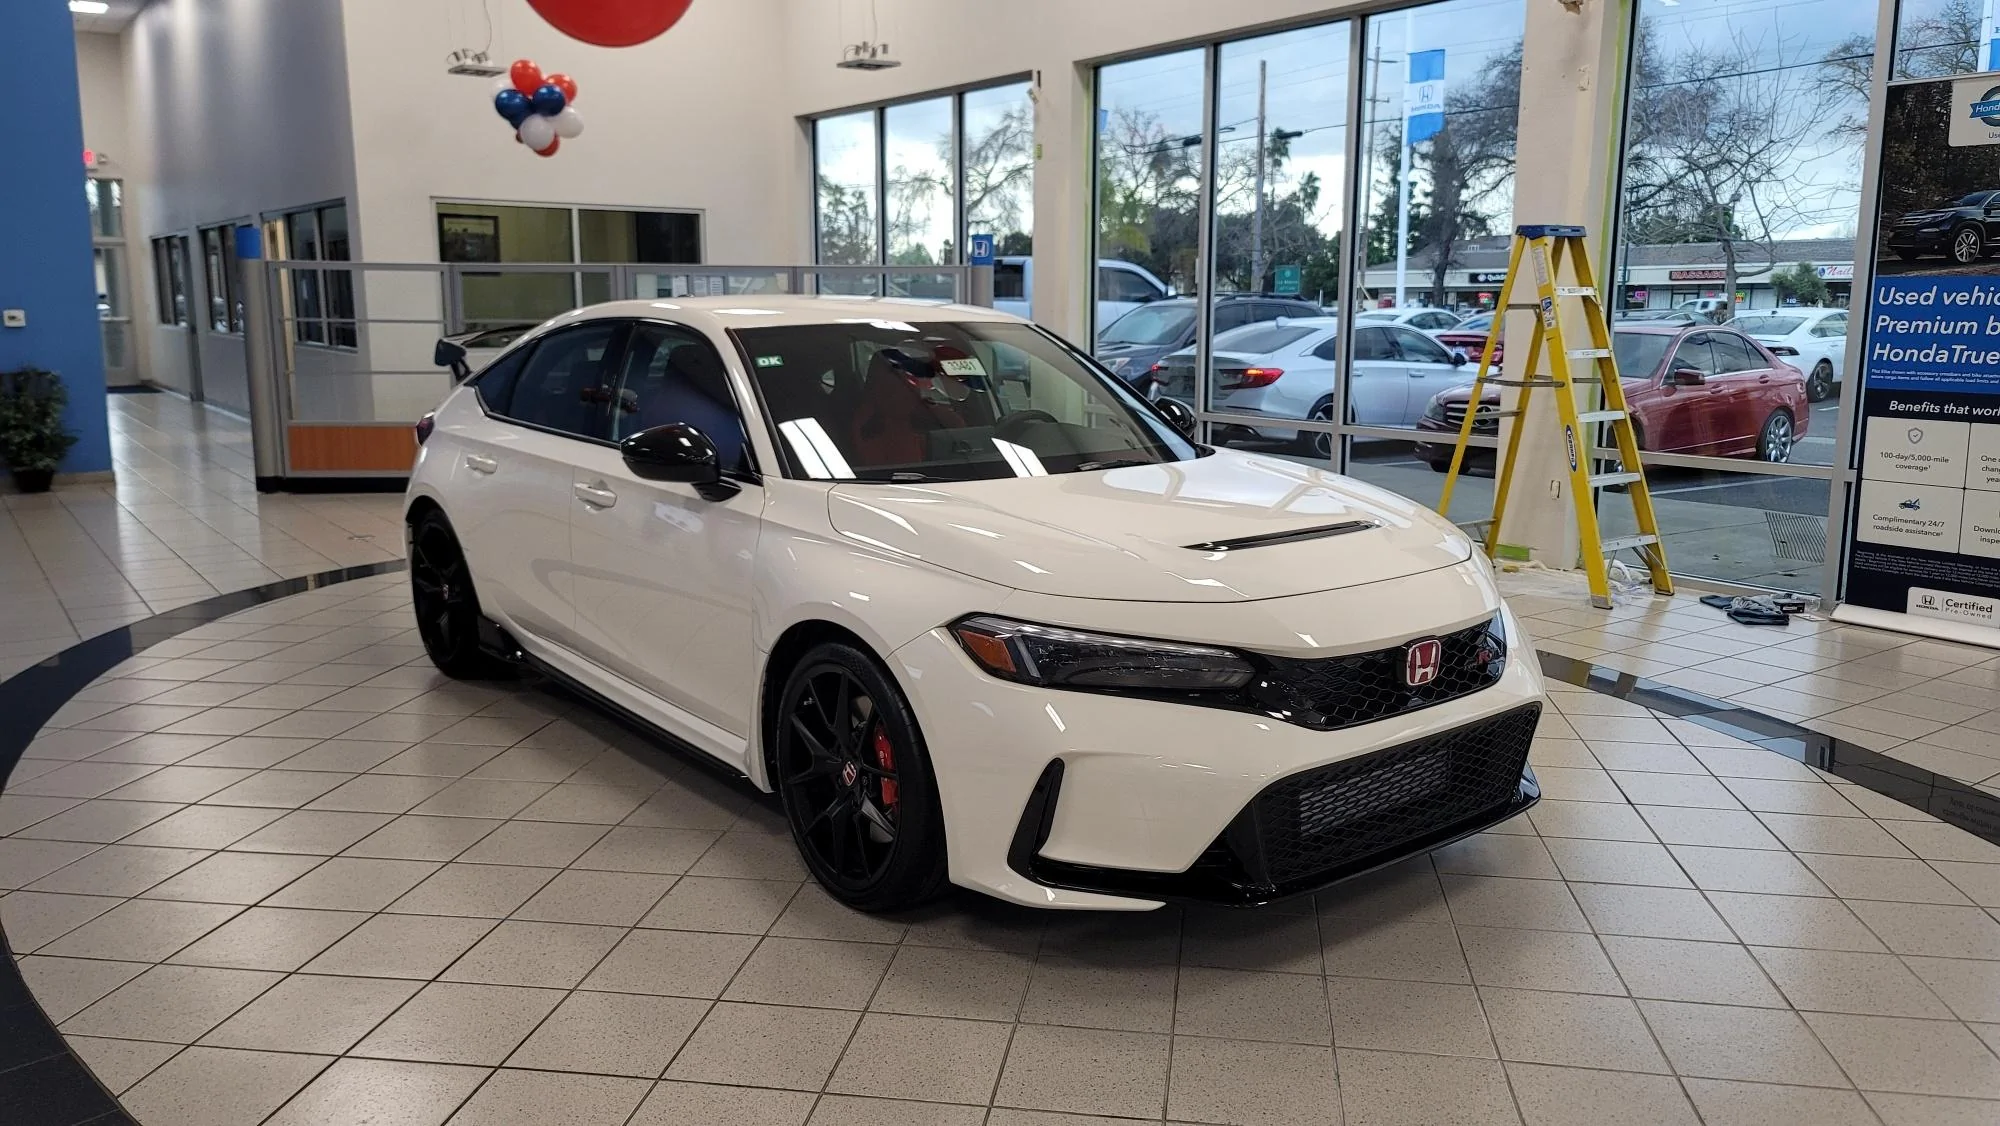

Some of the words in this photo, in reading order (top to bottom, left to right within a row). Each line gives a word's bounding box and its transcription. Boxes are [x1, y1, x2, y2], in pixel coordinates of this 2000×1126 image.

[1878, 285, 1937, 305] Used
[1876, 315, 1978, 335] Premium
[1873, 343, 2000, 365] HondaTrue
[758, 357, 782, 366] OK
[1889, 400, 1941, 413] Benefits
[1944, 403, 1969, 415] that
[1981, 455, 1997, 463] One
[1873, 514, 1927, 526] Complimentary
[1928, 520, 1945, 528] 24/7
[1873, 524, 1903, 533] roadside
[1945, 598, 1993, 613] Certified
[1945, 607, 1992, 620] Pre-Owned
